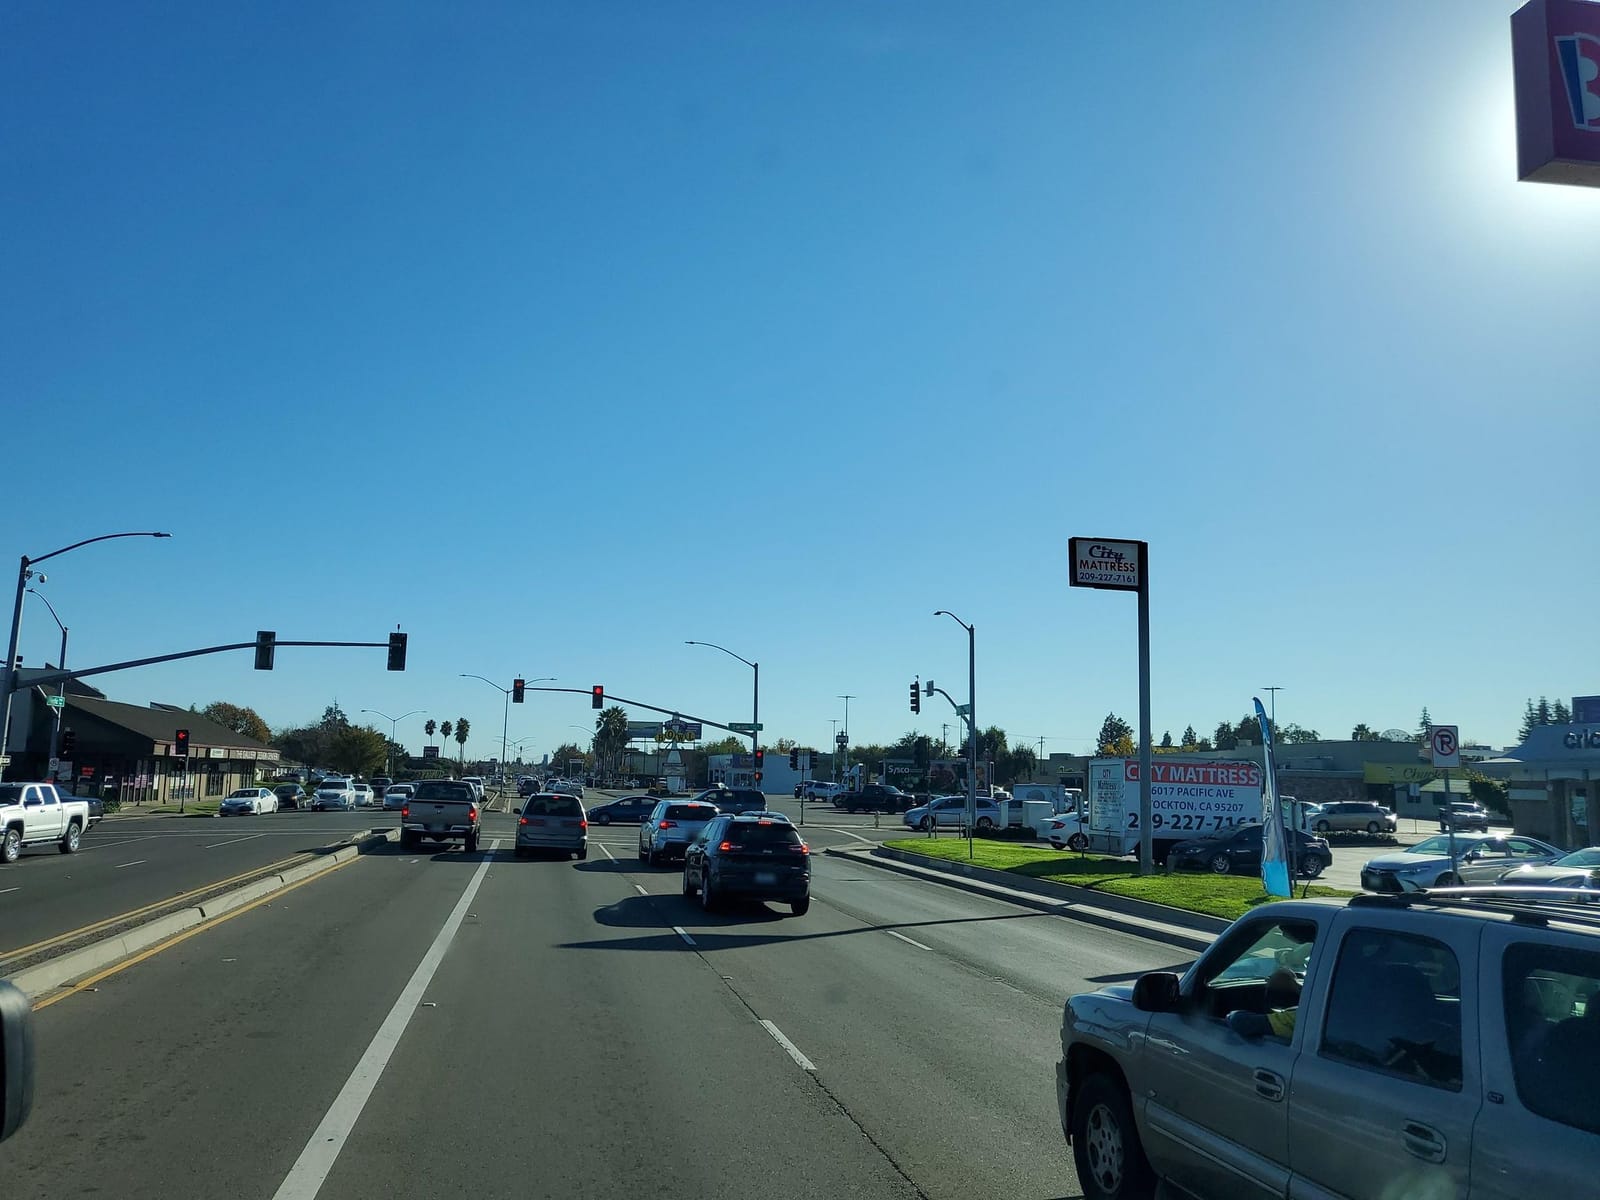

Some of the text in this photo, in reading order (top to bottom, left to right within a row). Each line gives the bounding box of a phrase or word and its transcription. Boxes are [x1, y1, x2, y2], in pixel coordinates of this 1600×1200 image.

[1088, 545, 1126, 562] City
[1079, 560, 1136, 573] MATTRESS
[1079, 572, 1136, 583] 209-227-7161
[1126, 764, 1259, 785] CY MATTRESS
[1151, 786, 1235, 799] 6017 PACIFIC AVE
[1152, 800, 1245, 812] OCKTON, CA 95207
[1127, 812, 1257, 830] 29-227-71
